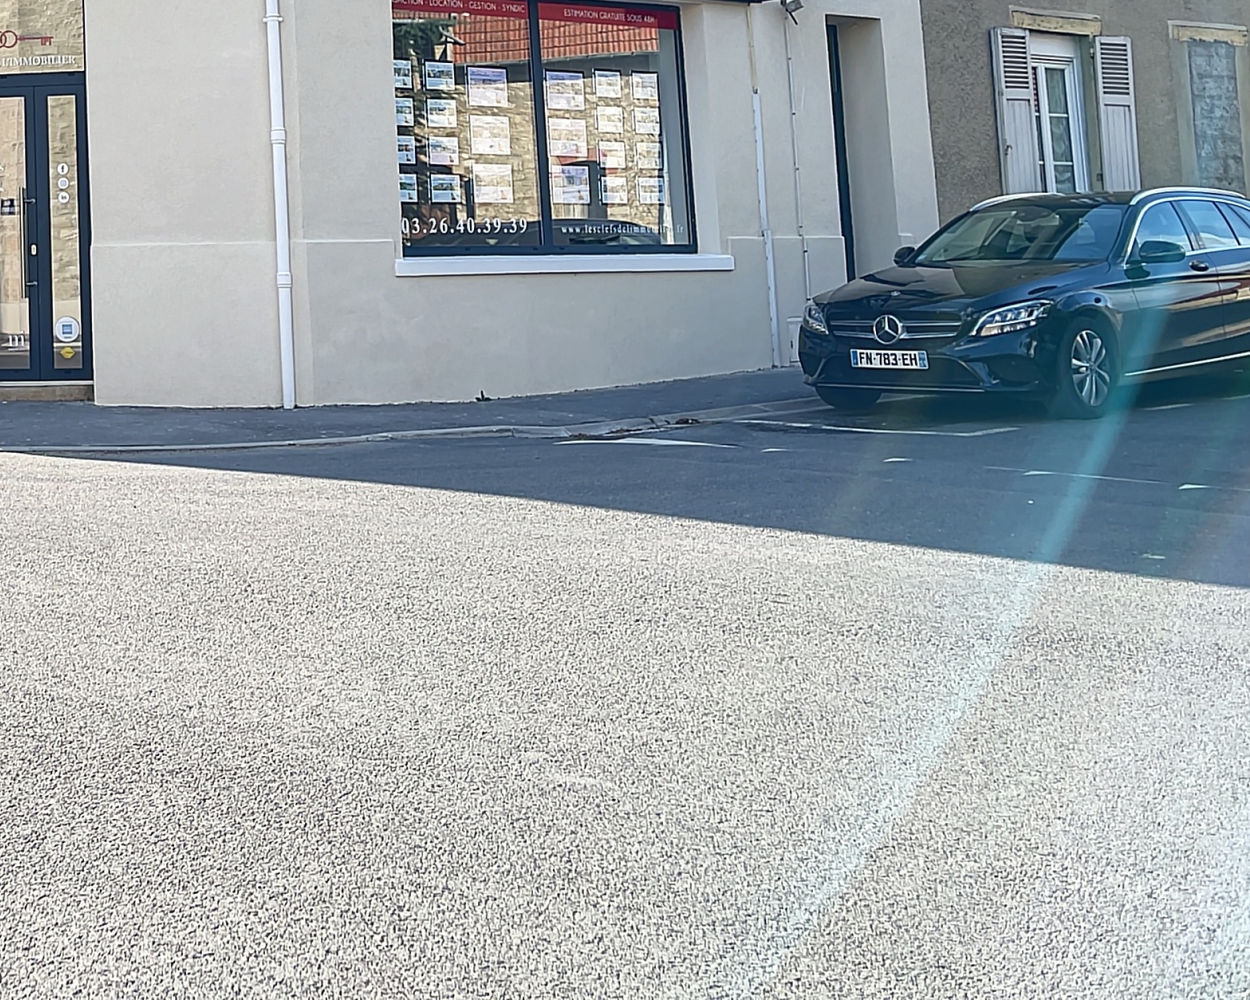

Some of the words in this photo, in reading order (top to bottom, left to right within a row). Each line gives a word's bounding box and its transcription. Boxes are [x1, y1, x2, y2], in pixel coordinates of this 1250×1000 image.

[468, 1, 496, 11] GESTION
[502, 4, 526, 13] SYNDIC
[563, 8, 598, 19] ESTIMATION
[599, 11, 626, 21] GRATUITE
[401, 217, 527, 234] 03.26.40.39.39
[858, 351, 918, 367] FN-783-EH
